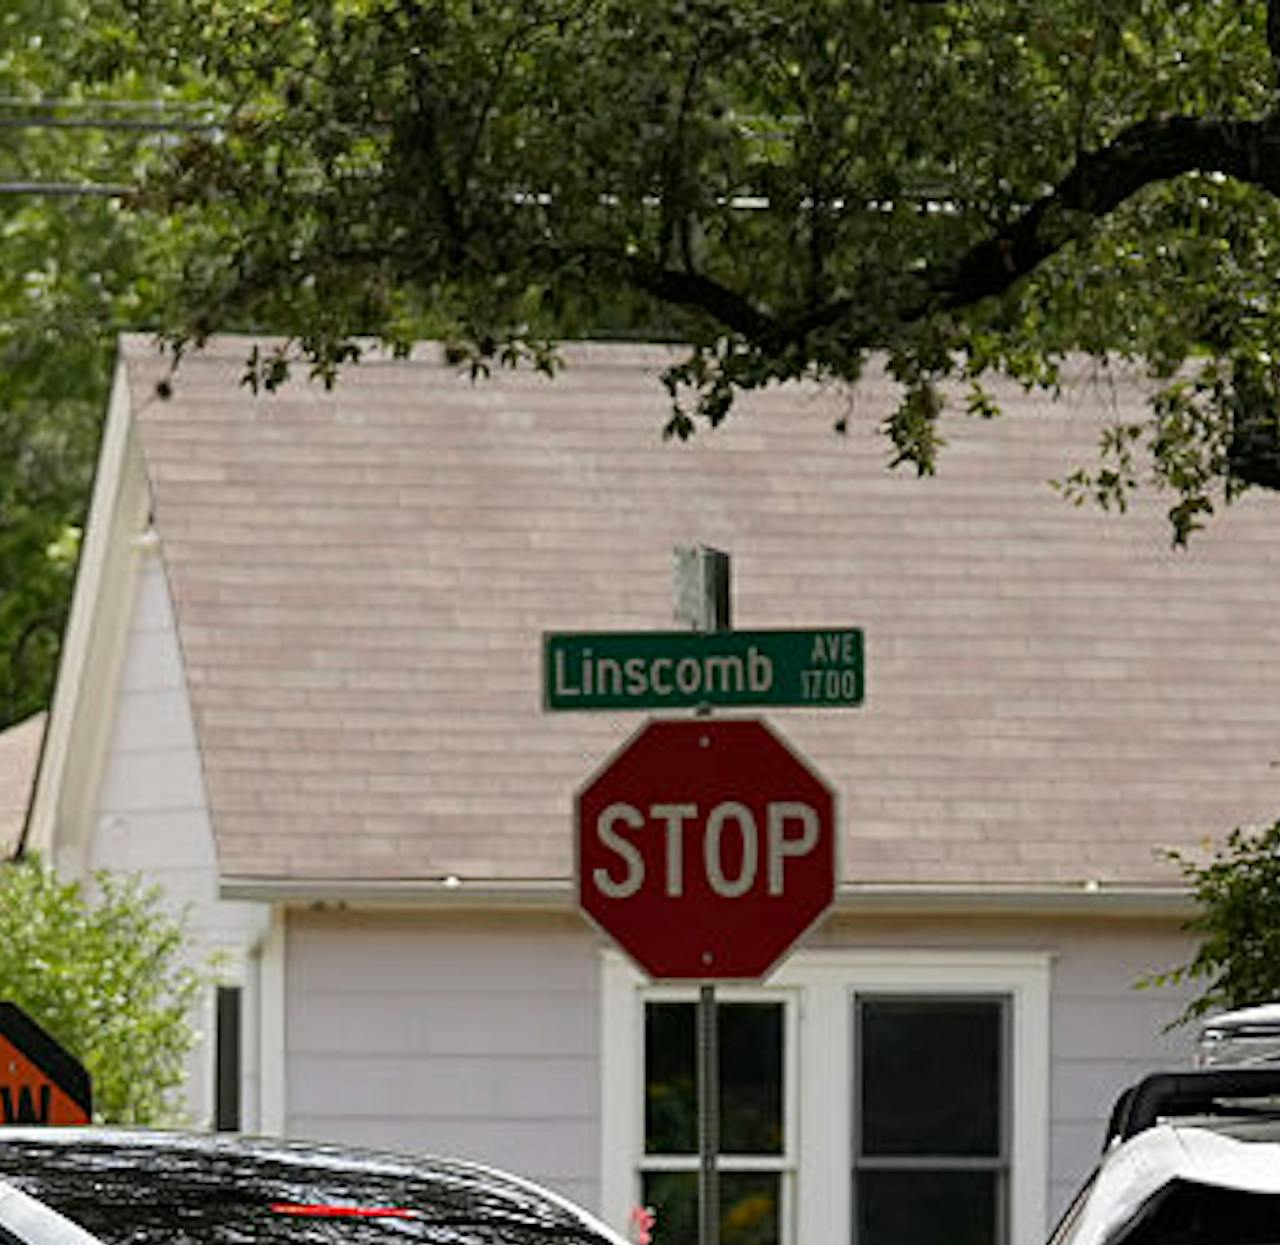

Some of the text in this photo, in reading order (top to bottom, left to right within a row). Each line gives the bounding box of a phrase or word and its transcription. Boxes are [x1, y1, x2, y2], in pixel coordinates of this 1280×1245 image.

[554, 633, 856, 696] Linscomb AVE
[592, 801, 820, 899] STOP
